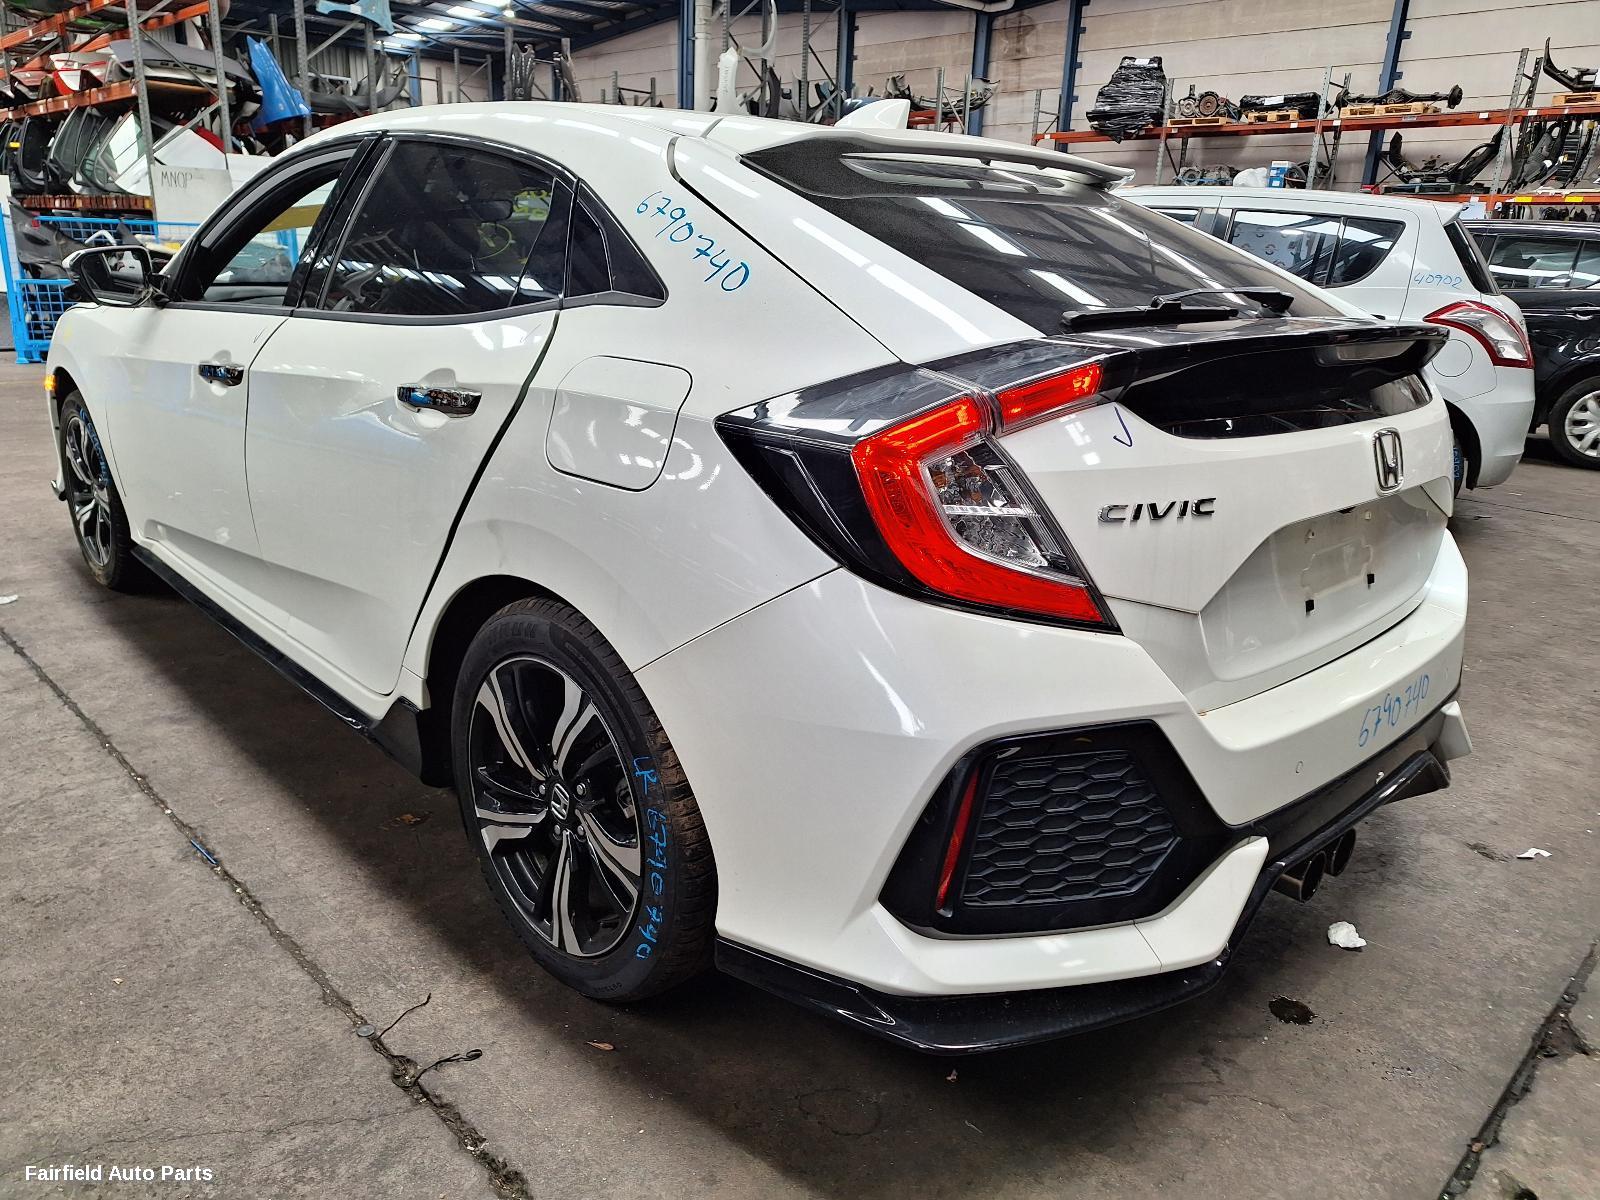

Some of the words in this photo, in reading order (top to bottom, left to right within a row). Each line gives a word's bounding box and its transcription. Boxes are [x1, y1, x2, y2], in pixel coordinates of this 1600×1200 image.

[160, 171, 193, 188] MNOP
[636, 190, 750, 292] 6790740
[1413, 272, 1463, 290] 40902
[1098, 497, 1217, 524] CIVIC
